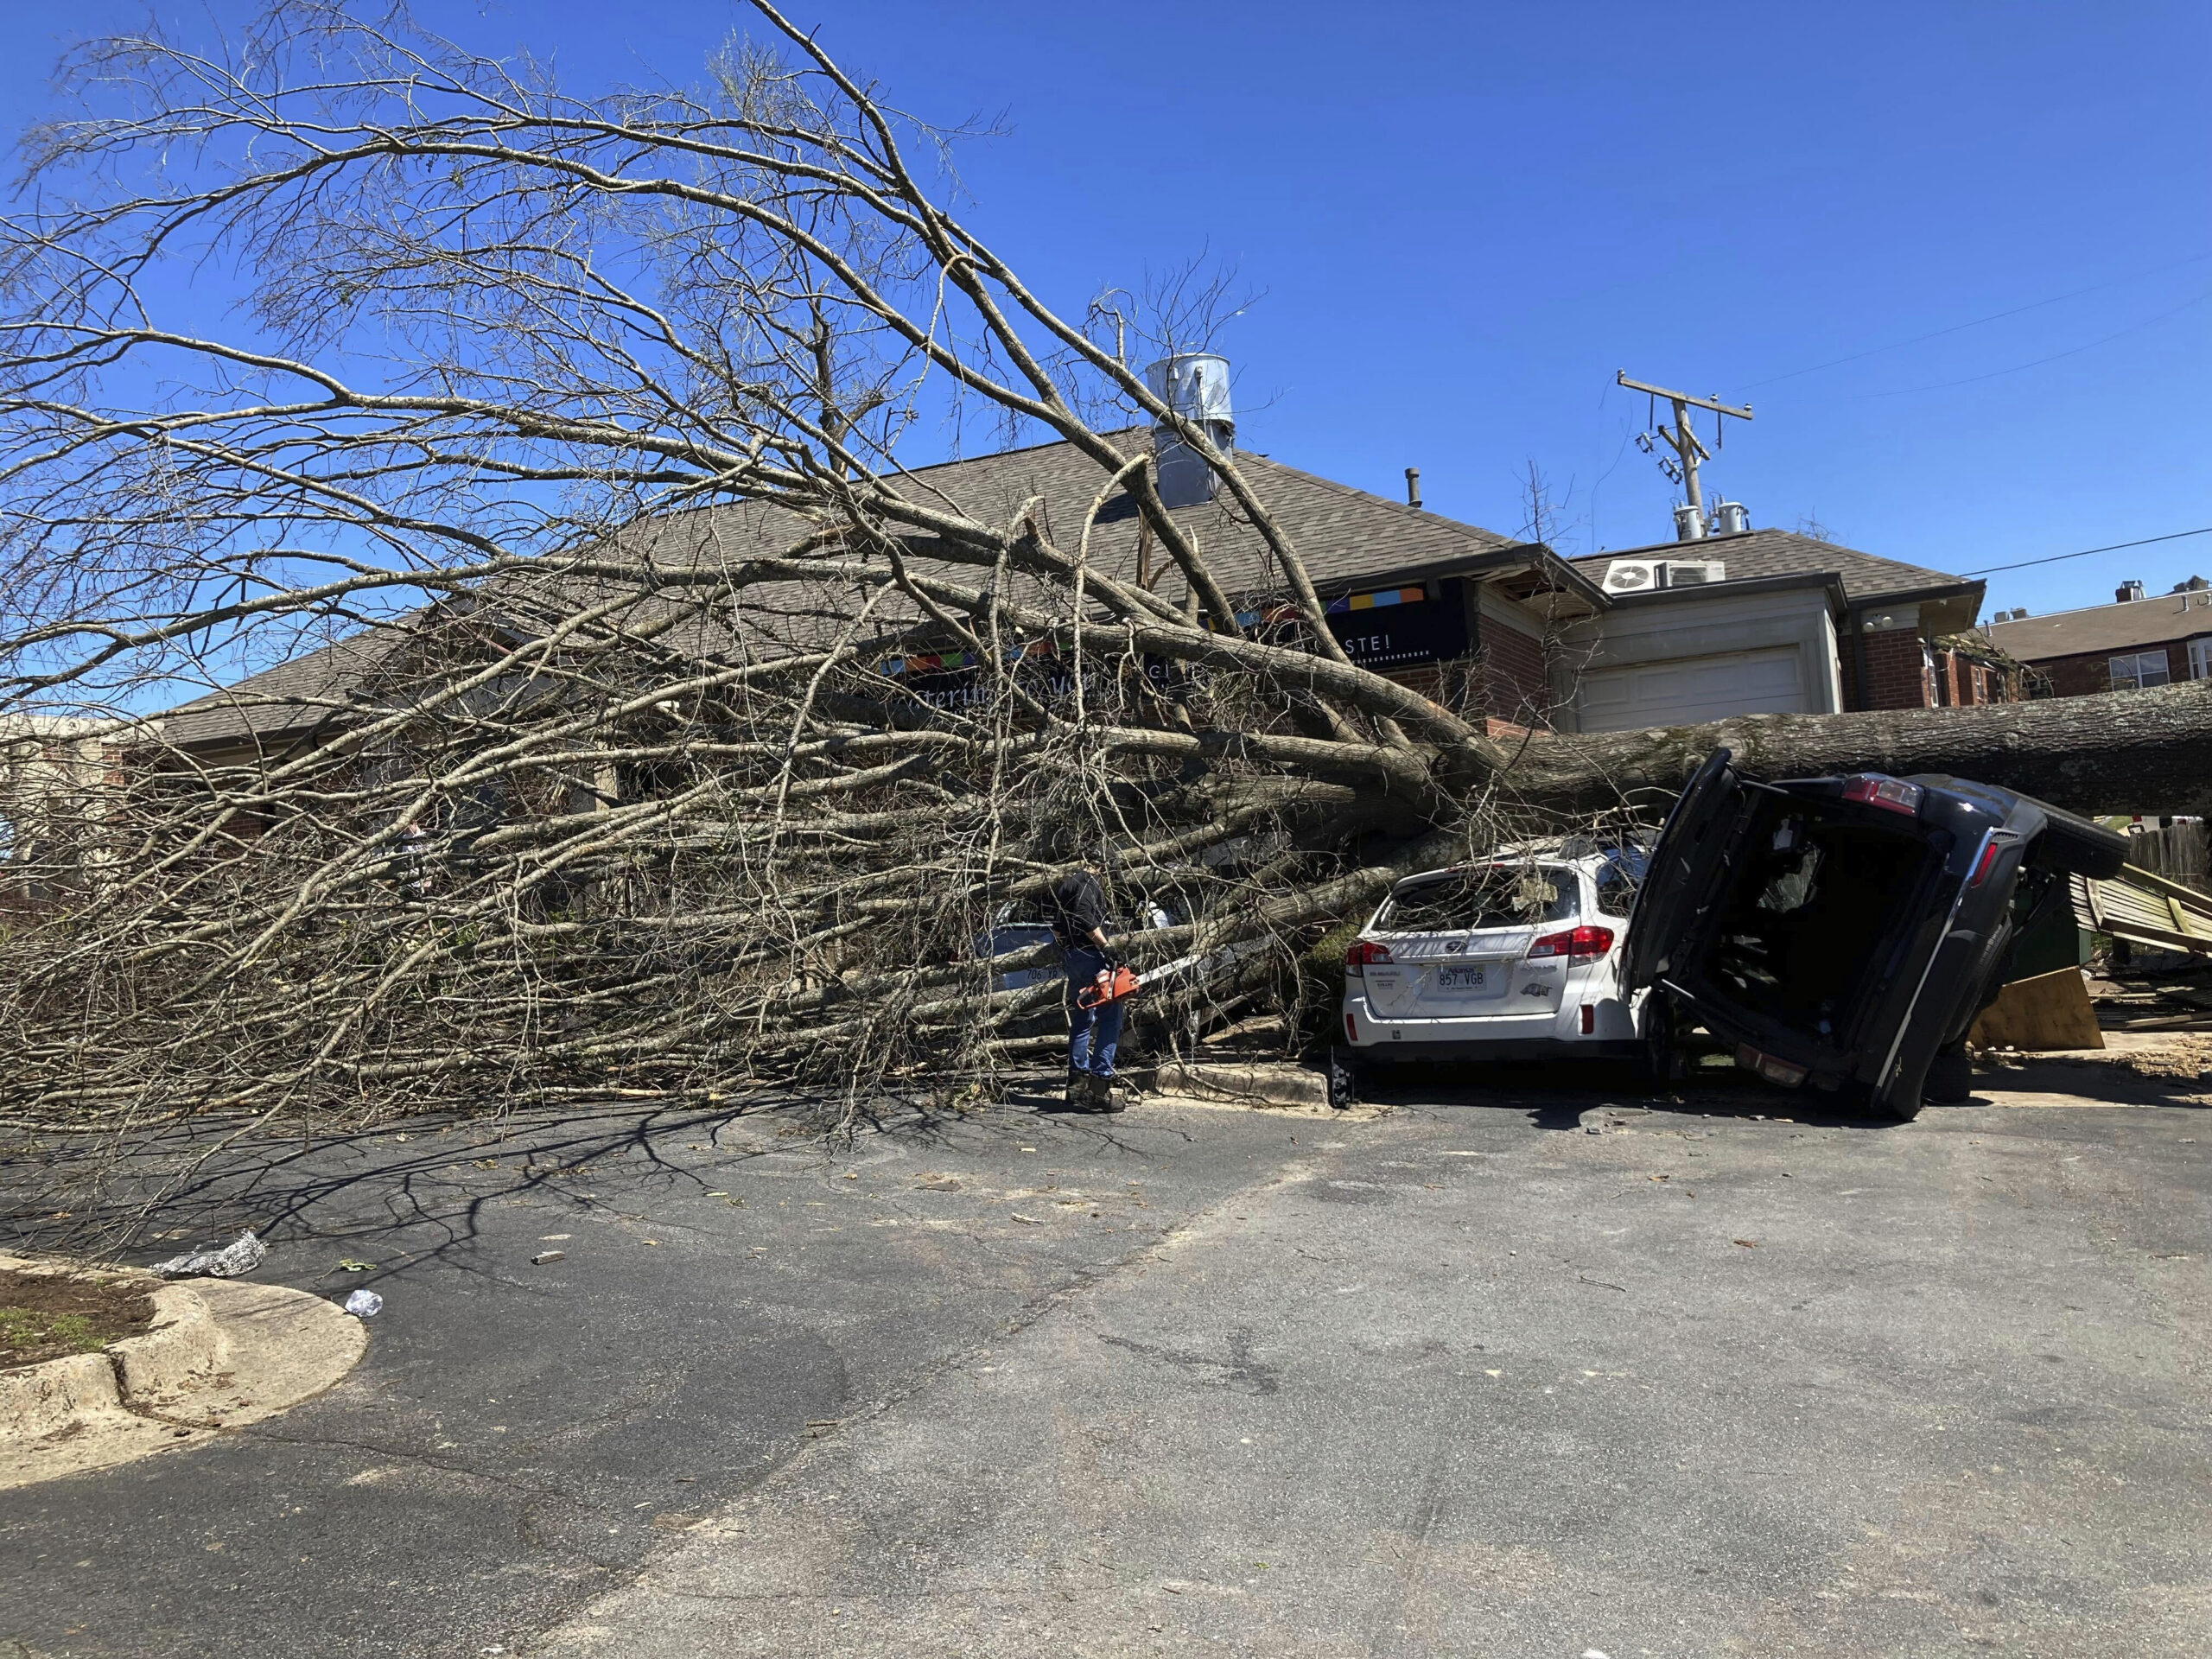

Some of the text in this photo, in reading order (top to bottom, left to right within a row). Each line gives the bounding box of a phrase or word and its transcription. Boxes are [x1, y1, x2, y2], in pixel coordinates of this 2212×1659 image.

[1344, 634, 1389, 654] STE!
[897, 681, 994, 710] terin
[1027, 969, 1042, 980] 706
[1439, 972, 1484, 986] 857 VGB
